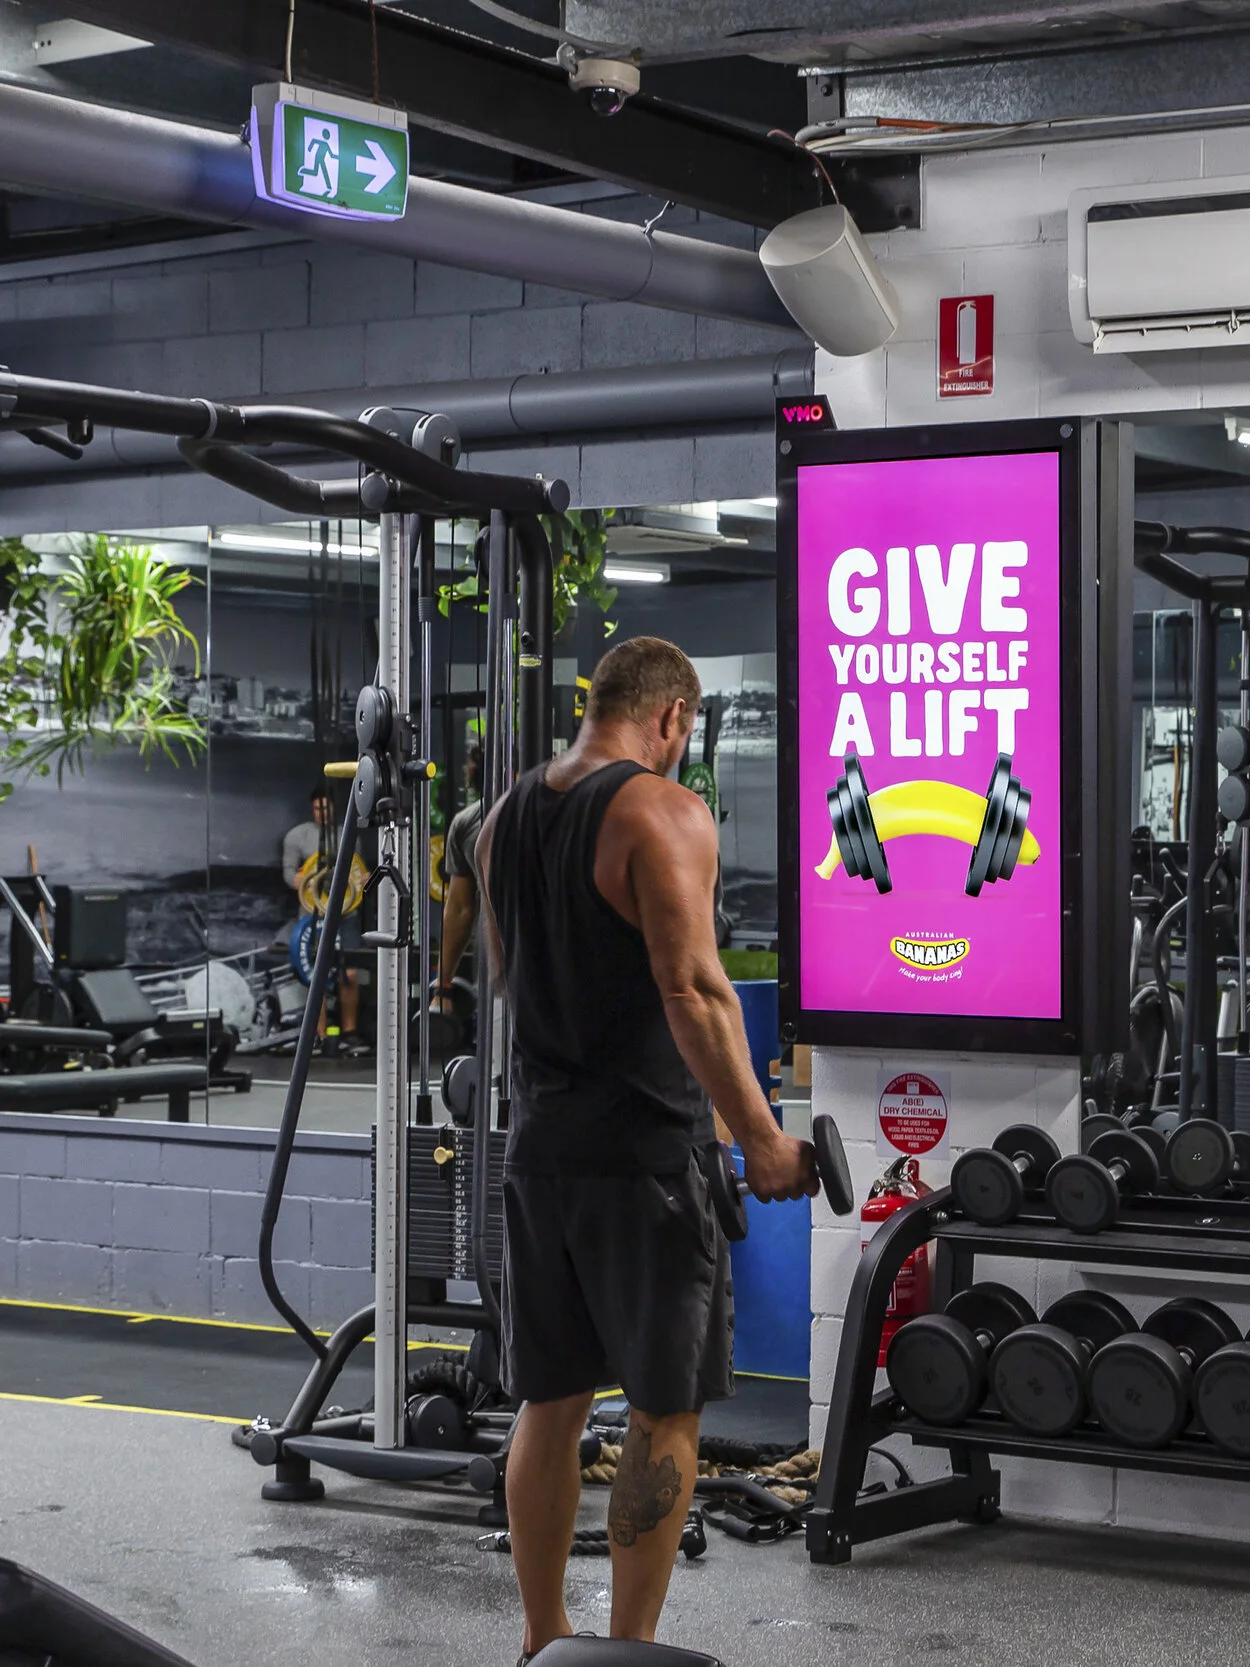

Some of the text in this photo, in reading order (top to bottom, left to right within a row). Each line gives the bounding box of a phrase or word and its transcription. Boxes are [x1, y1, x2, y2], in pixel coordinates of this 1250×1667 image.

[959, 368, 974, 378] FIRE
[943, 380, 990, 392] EXTINGUISHER
[782, 404, 823, 423] VMO
[827, 540, 1029, 637] GIVE
[827, 640, 1029, 685] YOURSELF
[829, 687, 1030, 758] A LIFT
[905, 931, 954, 939] AUSTRALIAN
[895, 940, 966, 966] BANANAS
[898, 967, 916, 979] Make
[915, 974, 932, 982] your
[932, 973, 949, 983] body
[902, 1097, 924, 1107] AB(E)
[884, 1106, 943, 1117] DRY CHEMICAL
